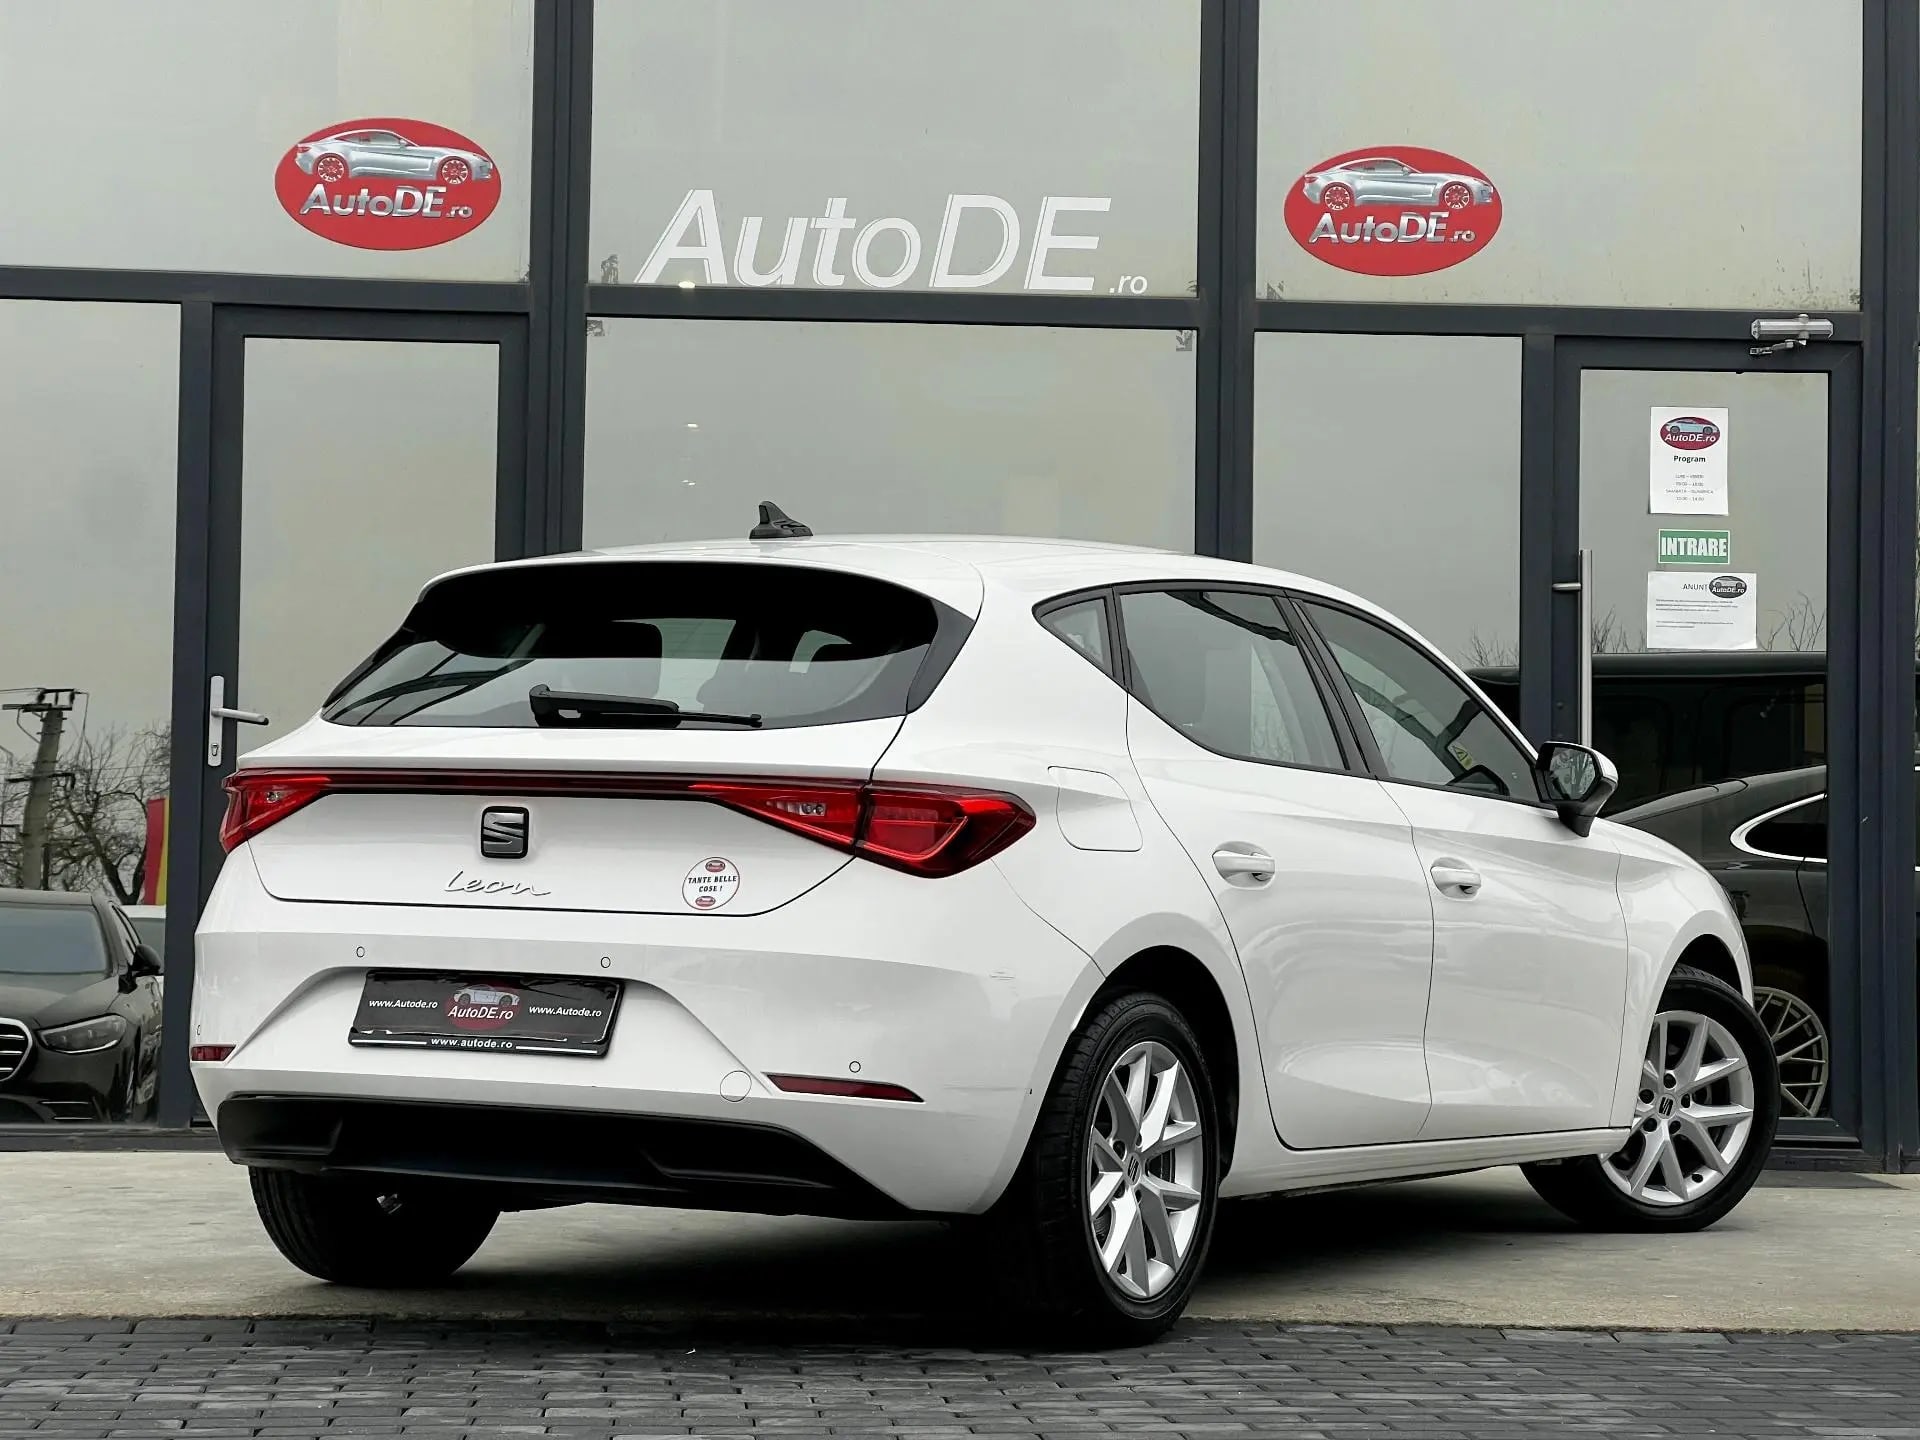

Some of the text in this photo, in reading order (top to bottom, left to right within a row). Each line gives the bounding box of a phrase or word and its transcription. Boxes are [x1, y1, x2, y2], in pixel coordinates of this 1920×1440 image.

[1664, 433, 1717, 443] AutoDE.ro
[1673, 455, 1706, 463] Program
[1661, 537, 1727, 556] INTRARE
[444, 870, 551, 896] Leon
[688, 875, 738, 884] TANTE BELLE
[698, 885, 718, 893] COSE
[368, 998, 438, 1009] www.Autode.ro
[447, 1005, 514, 1021] AutoDE.ro
[528, 1004, 602, 1018] www.Autode.ro
[430, 1036, 513, 1050] www.autode.ro
